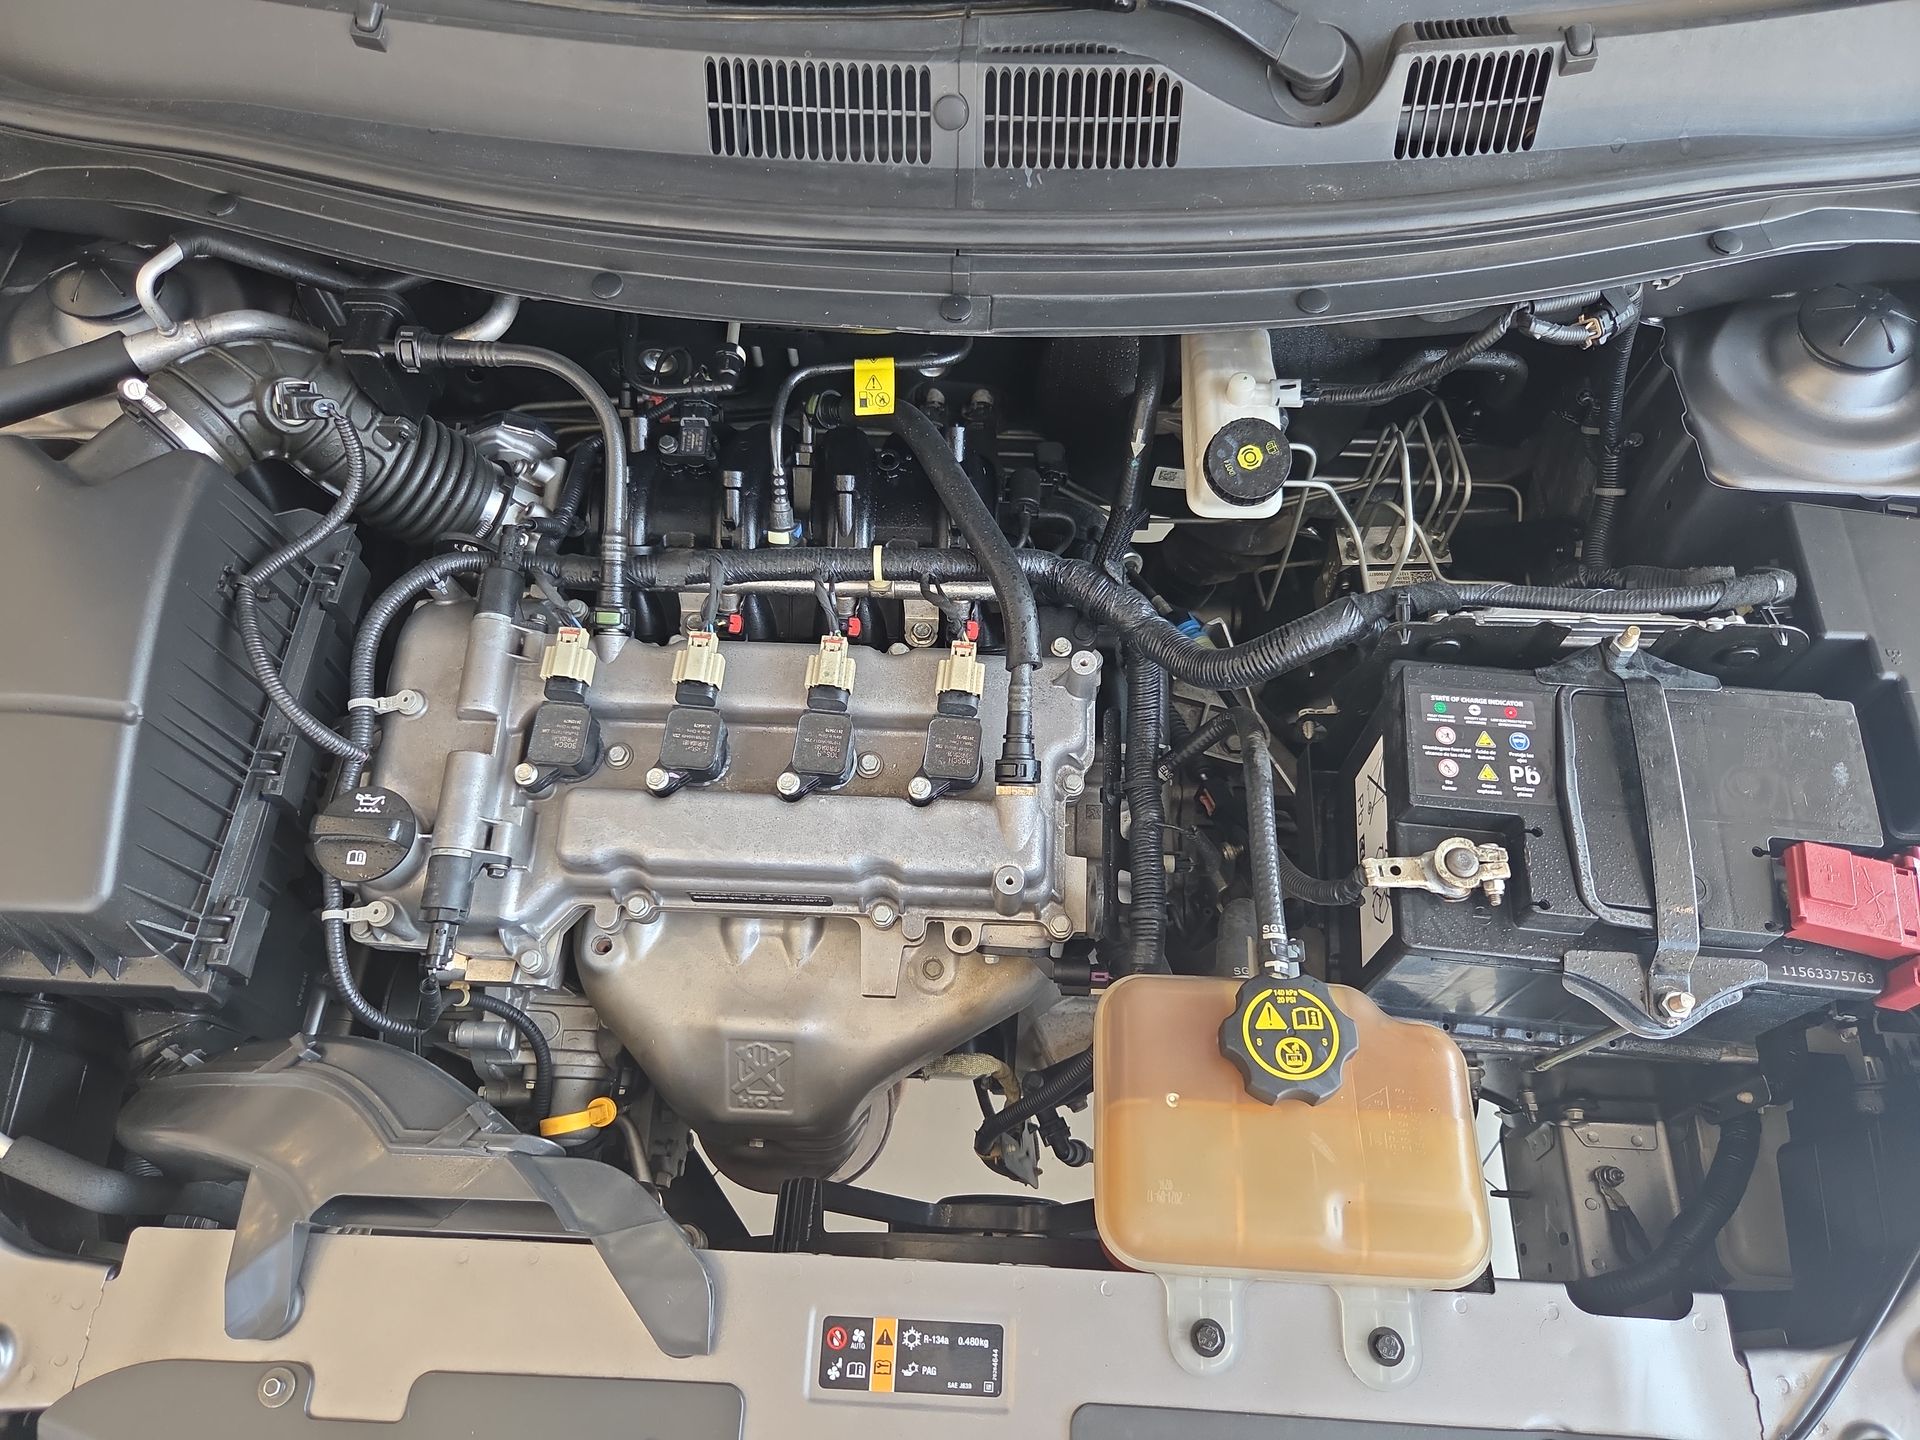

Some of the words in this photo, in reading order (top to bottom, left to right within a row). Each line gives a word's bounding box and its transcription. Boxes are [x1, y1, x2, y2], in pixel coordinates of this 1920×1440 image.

[1460, 697, 1487, 705] CHARGE
[1488, 699, 1524, 707] INDICATOR
[1159, 765, 1174, 778] ENG
[1509, 766, 1541, 785] Pb
[1358, 793, 1364, 826] Pb
[1262, 924, 1285, 933] SGT
[1233, 967, 1249, 975] SG
[1781, 965, 1874, 984] 11563375763
[737, 1095, 784, 1109] HOT
[923, 1334, 949, 1345] R-134a
[850, 1342, 866, 1350] AUTO
[921, 1366, 937, 1376] PAG
